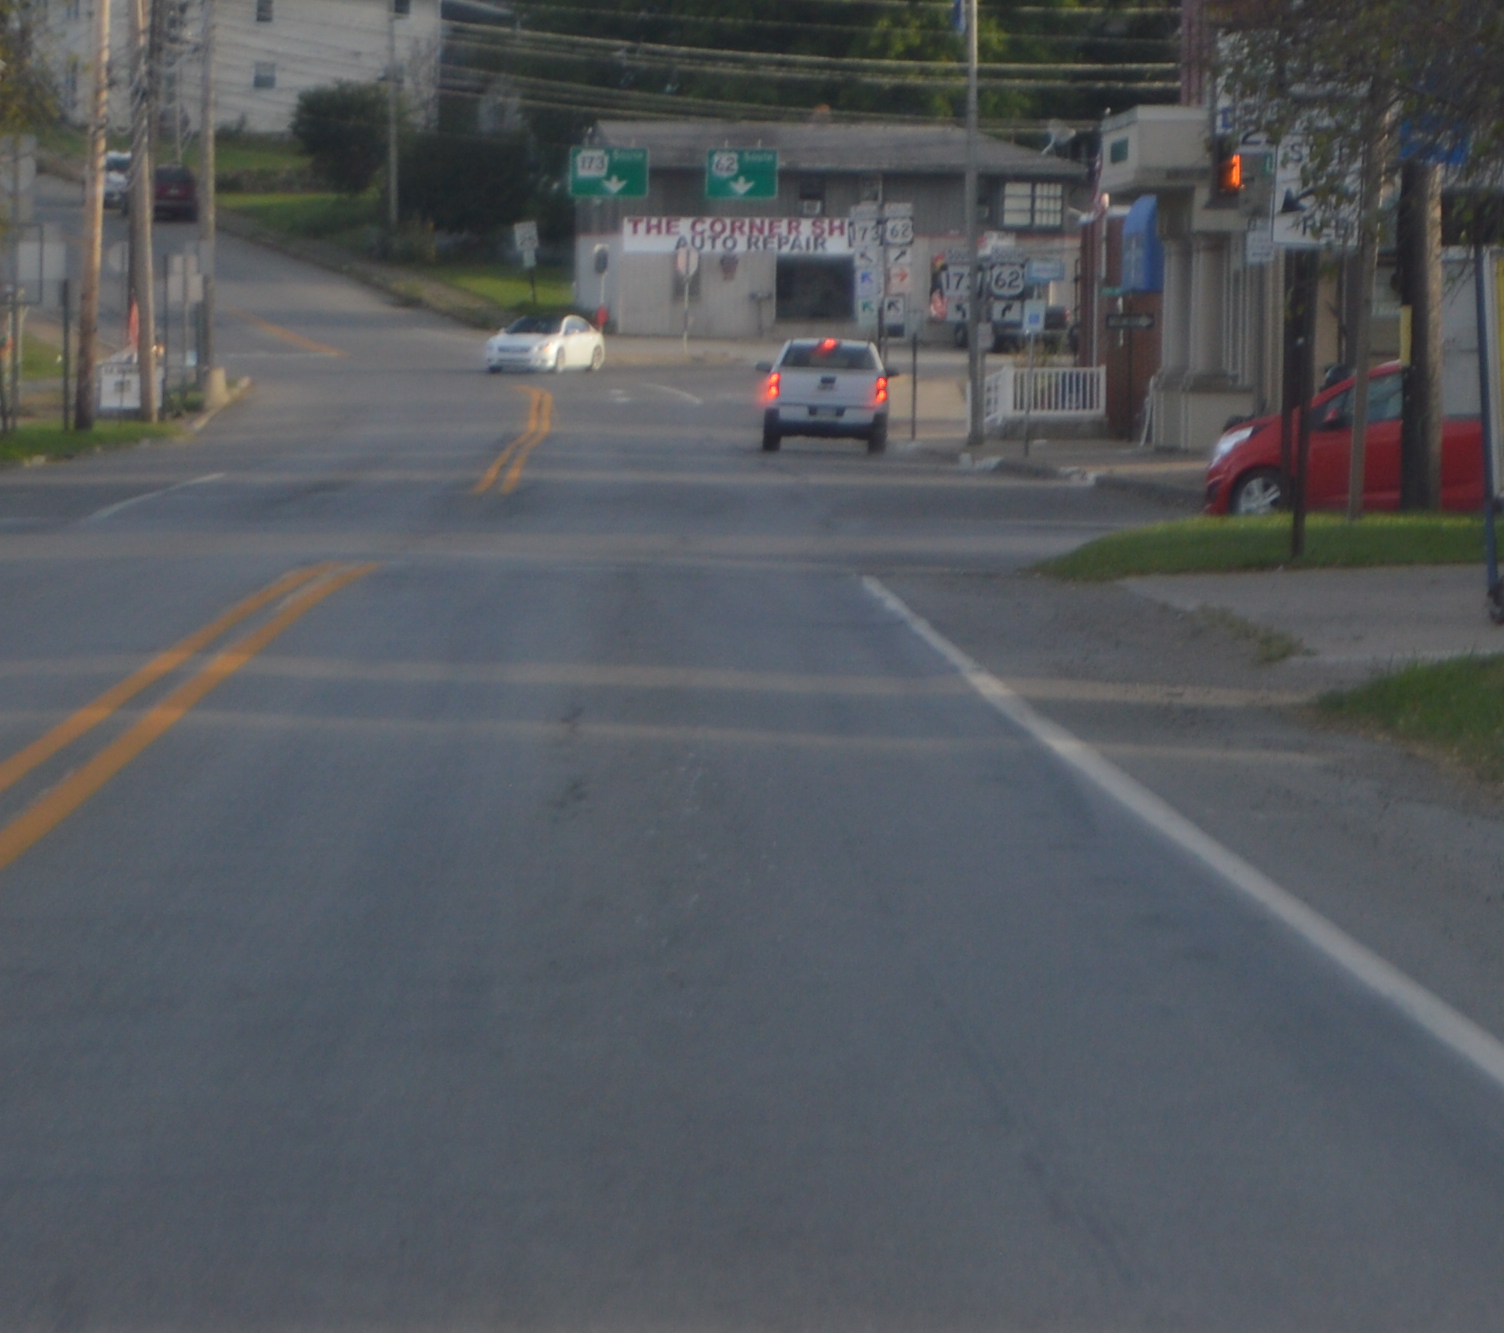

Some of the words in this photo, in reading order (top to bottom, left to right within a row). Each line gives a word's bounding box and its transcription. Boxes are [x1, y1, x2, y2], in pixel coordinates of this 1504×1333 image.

[580, 155, 605, 171] 173
[715, 156, 736, 172] 62
[627, 218, 681, 236] THE
[690, 218, 802, 236] CORNER
[811, 218, 846, 236] SH
[889, 219, 911, 240] 62
[674, 235, 738, 251] AUTO
[746, 235, 828, 251] REPAIR
[994, 272, 1021, 290] 62
